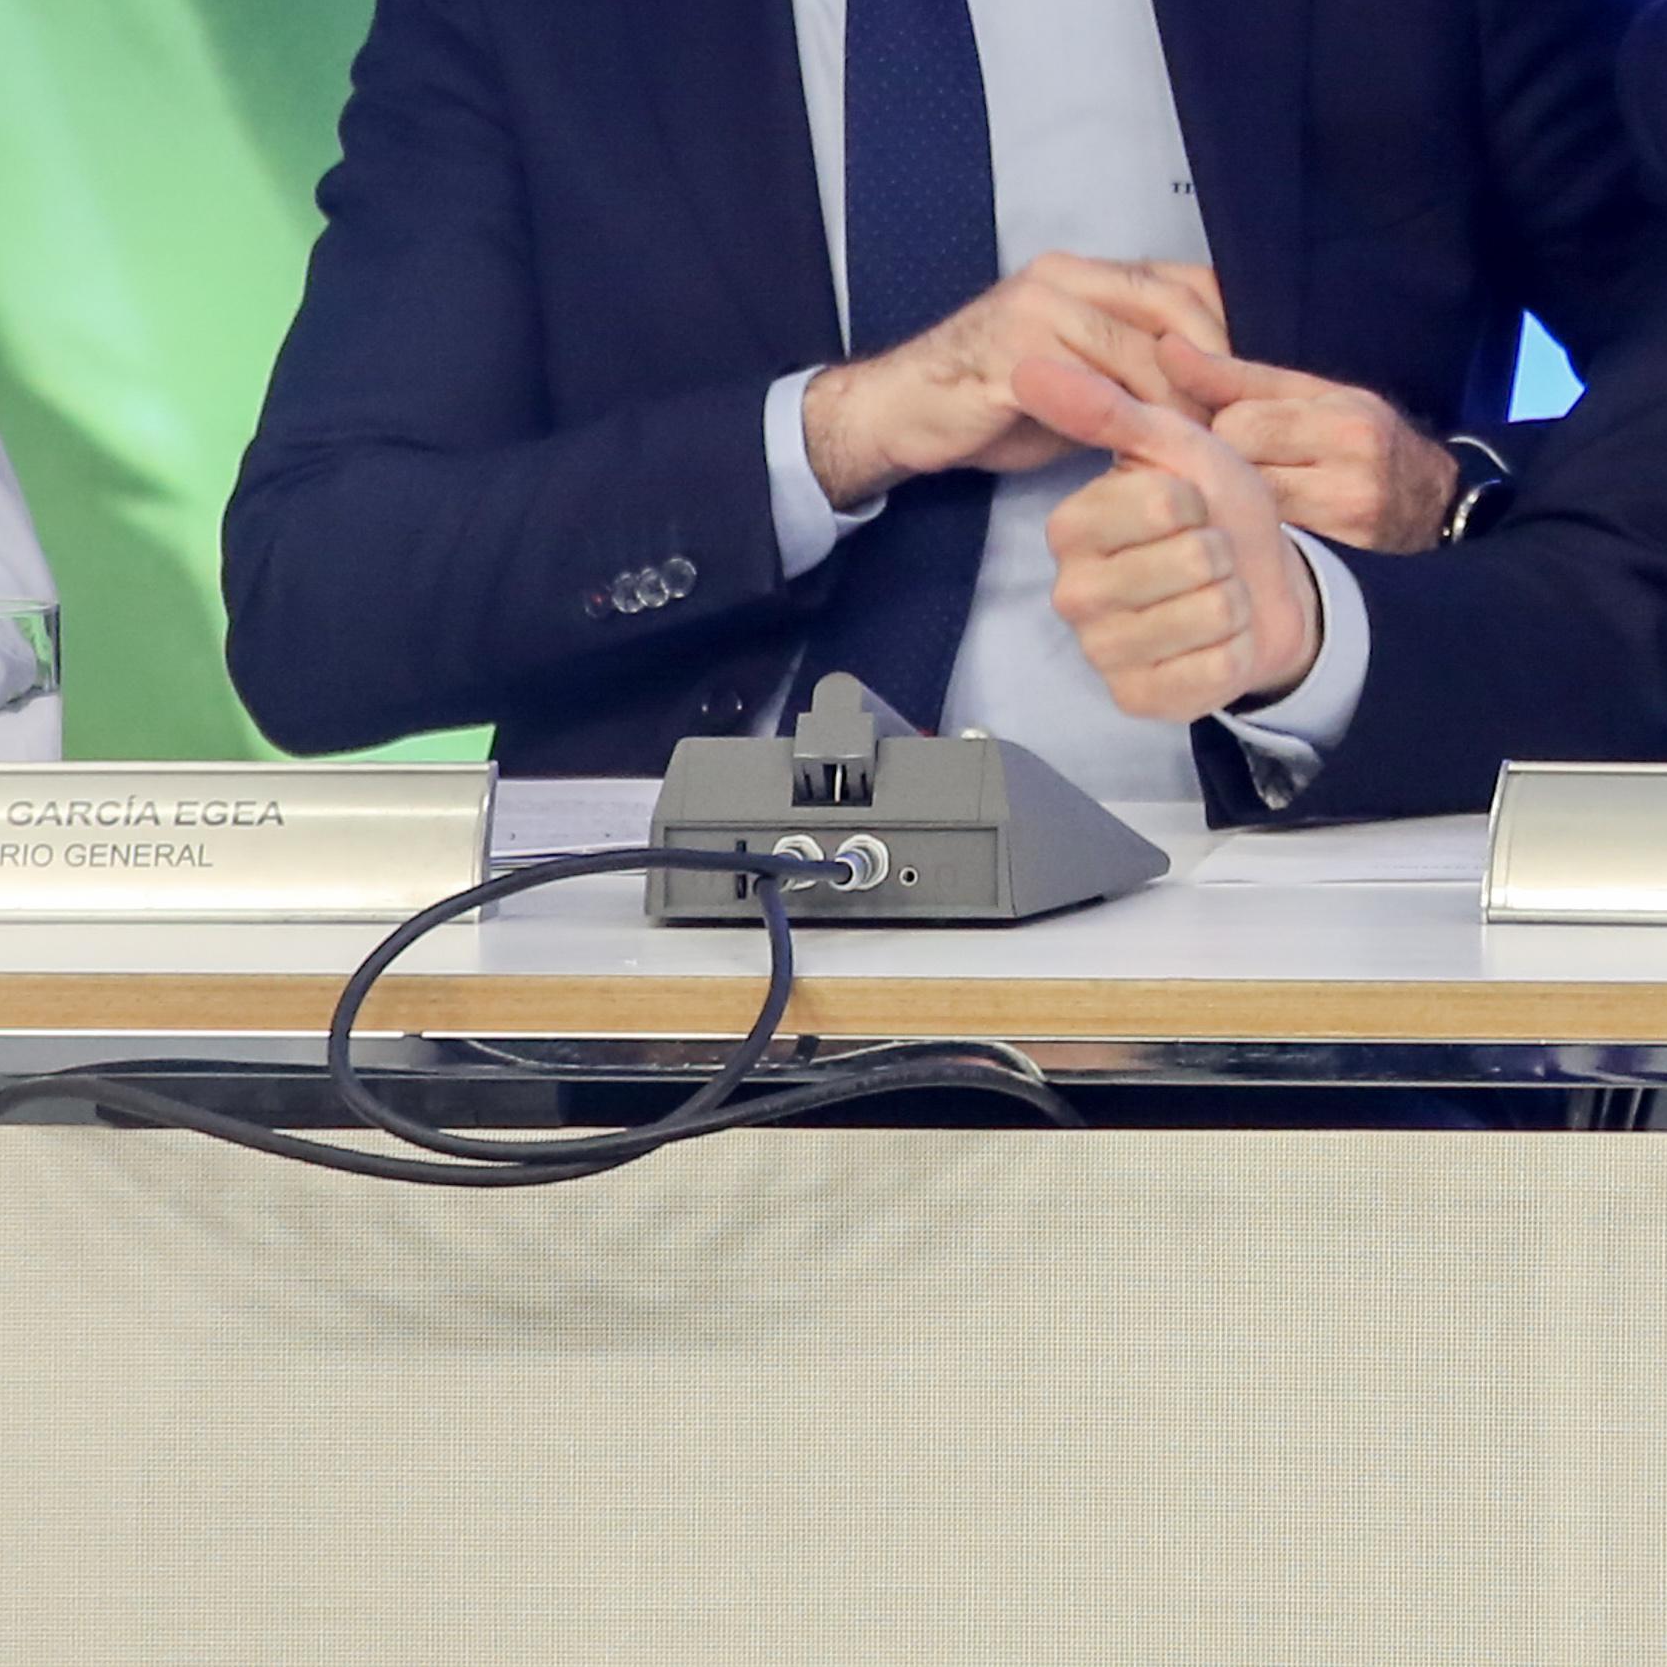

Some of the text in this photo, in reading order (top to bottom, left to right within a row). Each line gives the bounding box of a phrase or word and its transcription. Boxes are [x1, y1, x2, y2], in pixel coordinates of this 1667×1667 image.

[6, 794, 160, 827] GARCÍA
[174, 800, 284, 827] EGEA
[64, 843, 213, 868] GENERAL
